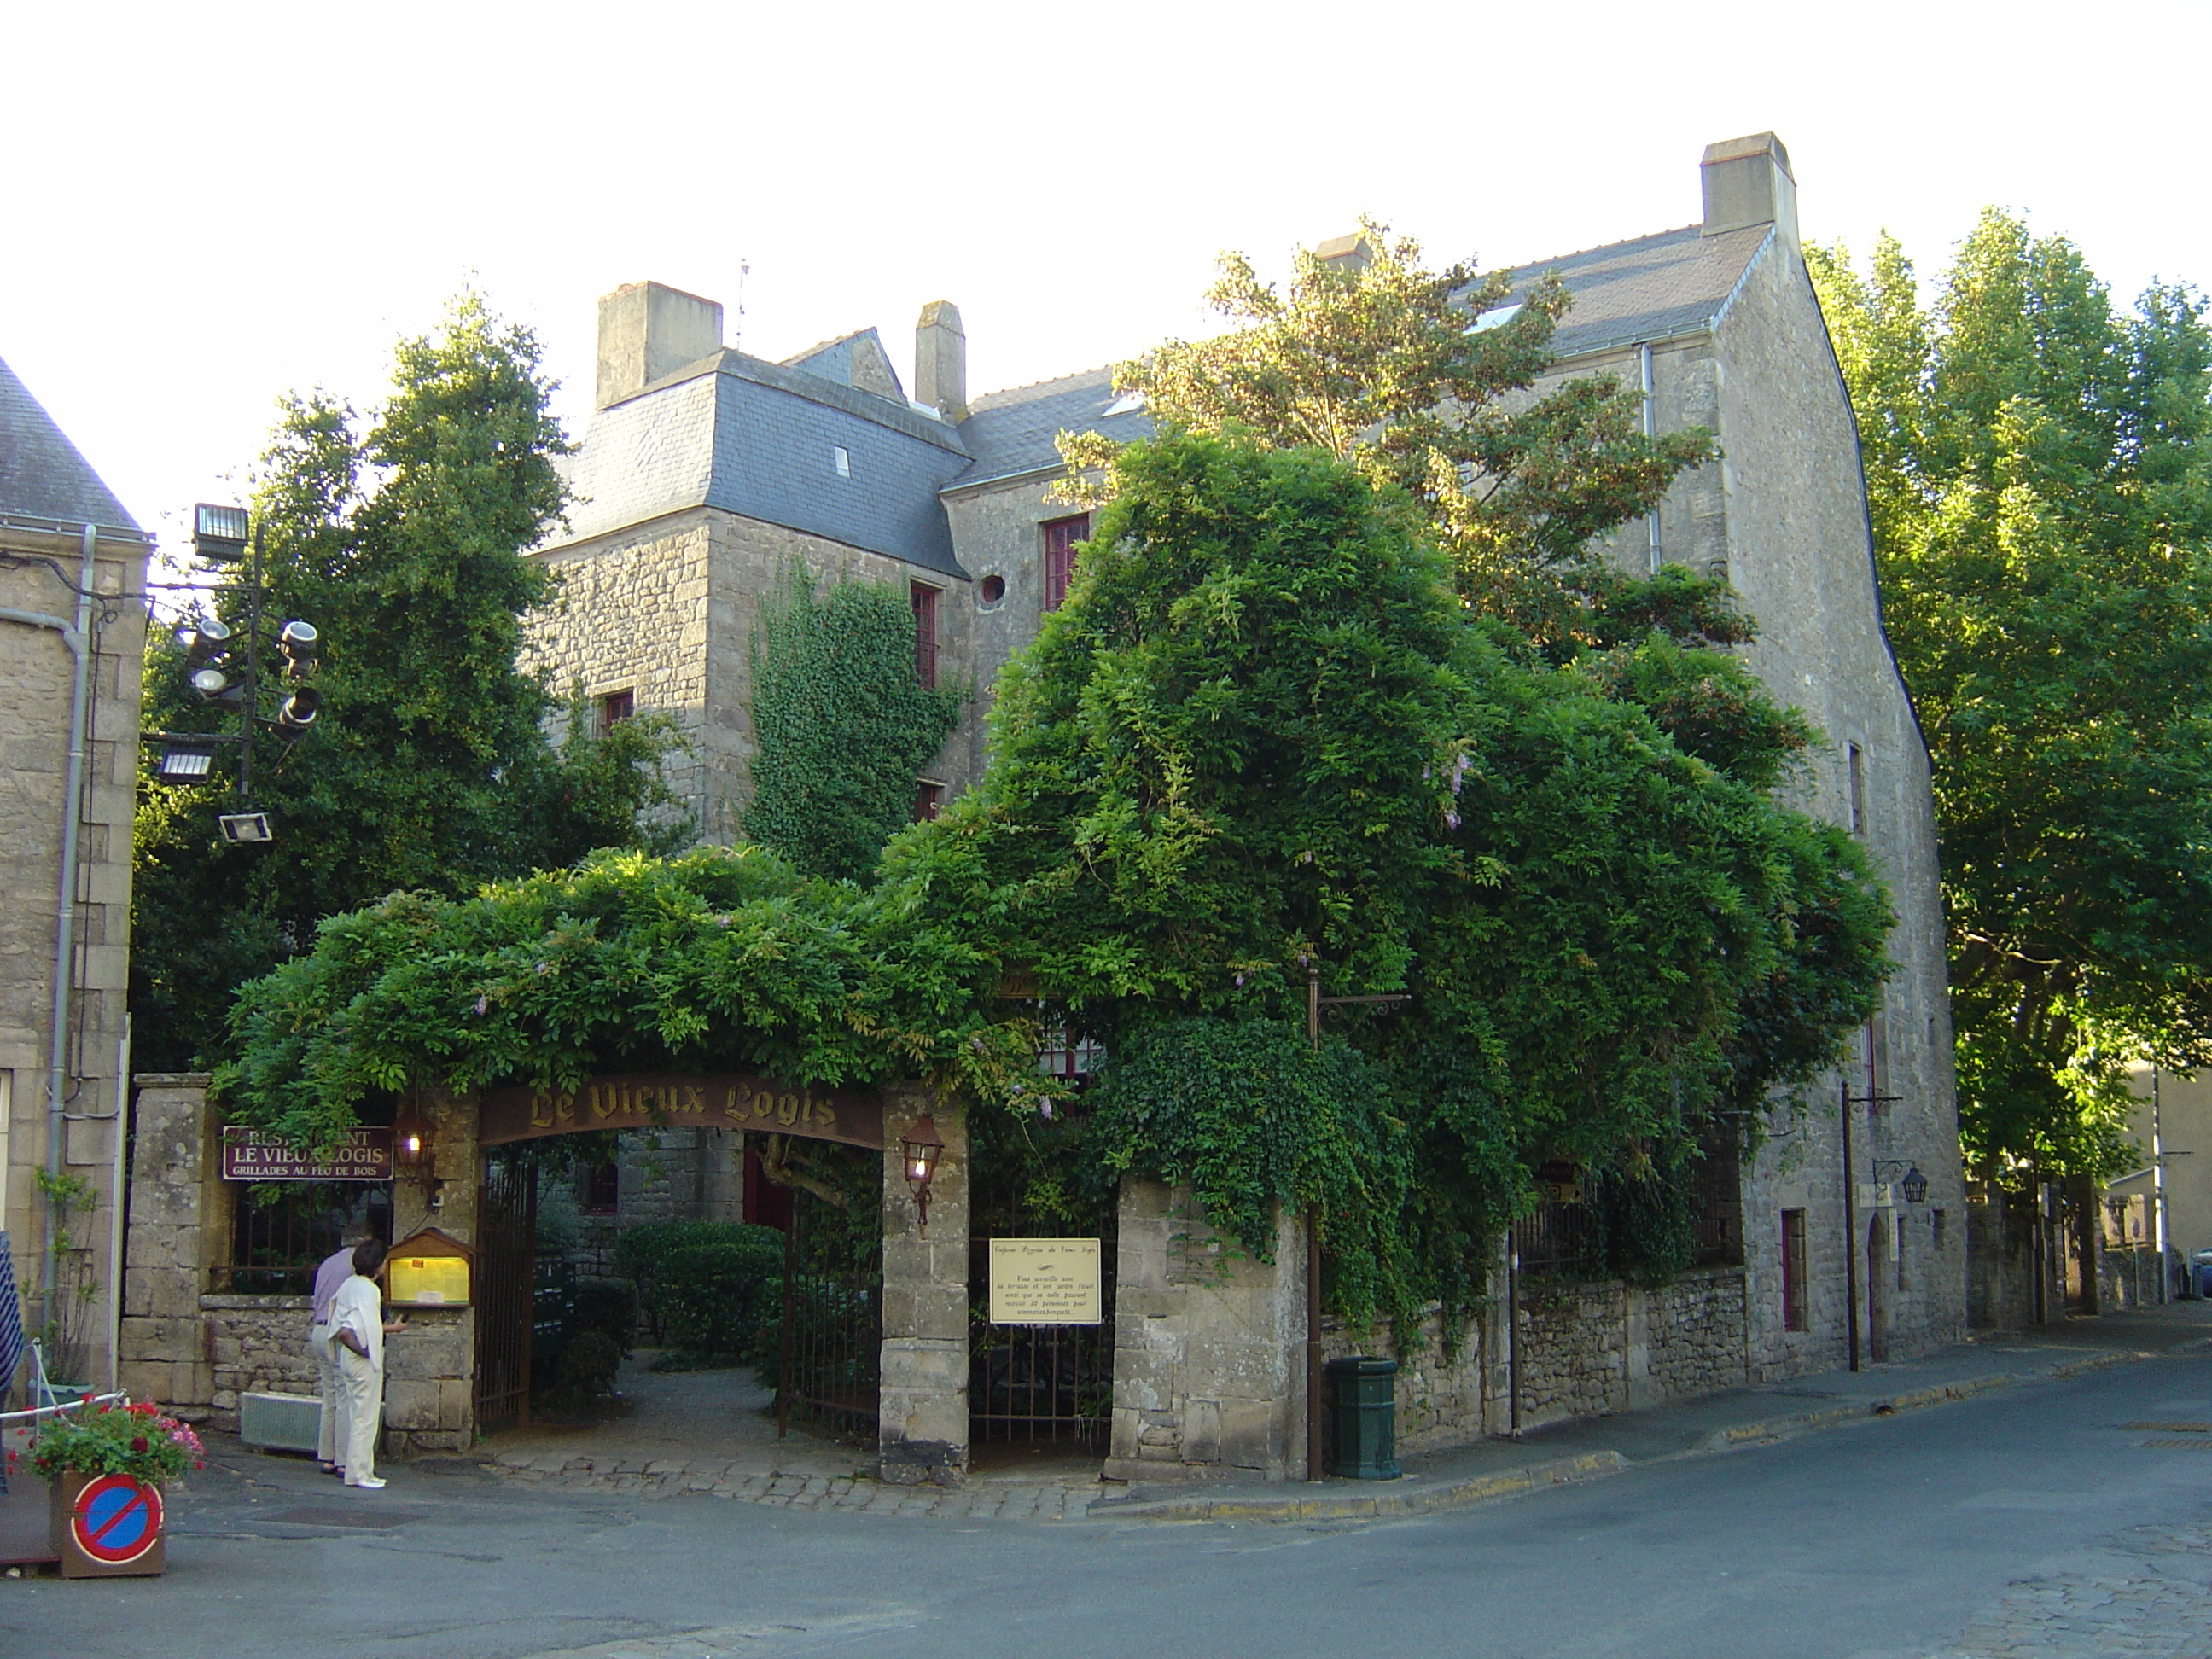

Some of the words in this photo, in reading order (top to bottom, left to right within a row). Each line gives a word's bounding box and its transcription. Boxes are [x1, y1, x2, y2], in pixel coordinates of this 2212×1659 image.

[530, 1091, 575, 1128] Le
[588, 1081, 706, 1120] Vieux
[724, 1081, 837, 1127] Logis
[234, 1148, 258, 1163] LE
[233, 1166, 288, 1176] GRILLADES
[293, 1167, 307, 1176] AU
[311, 1167, 333, 1176] FEU
[335, 1167, 349, 1176] DE
[354, 1167, 377, 1176] BOIS
